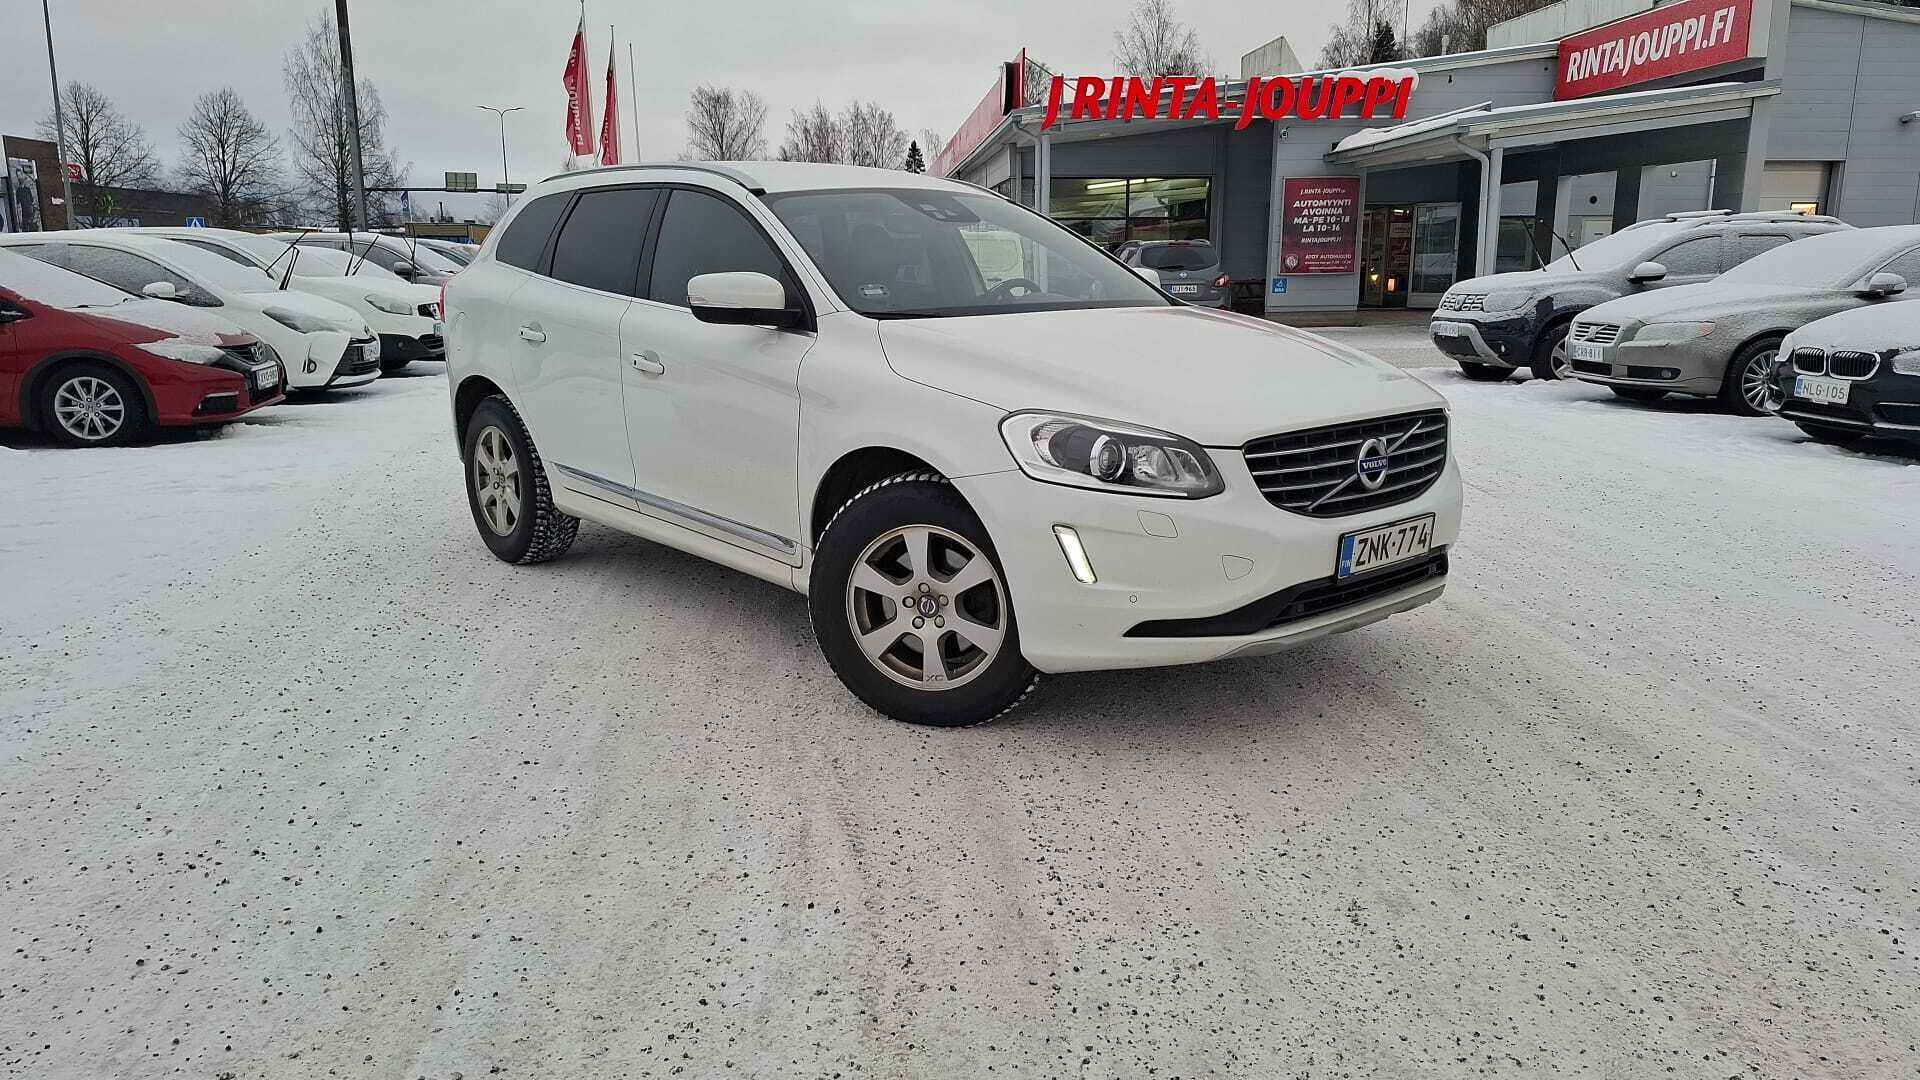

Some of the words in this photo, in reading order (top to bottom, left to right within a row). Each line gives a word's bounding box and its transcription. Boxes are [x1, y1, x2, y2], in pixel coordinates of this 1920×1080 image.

[1565, 5, 1737, 83] RINTAJOUPPI.FI
[1041, 75, 1064, 131] J
[1071, 75, 1416, 131] RINTA-JOUPPI
[1293, 199, 1352, 208] AUTOMYYNTI
[1302, 208, 1343, 216] AVOINNA
[1293, 216, 1325, 225] MA-PE
[1326, 215, 1350, 224] 10-18
[1302, 225, 1315, 233] LA
[1317, 224, 1341, 232] 10-16
[1803, 382, 1846, 400] NLG-105
[1361, 459, 1387, 470] VOLVO
[1355, 522, 1428, 567] ZNK-774
[1341, 559, 1352, 569] FIN
[926, 674, 945, 683] XC
